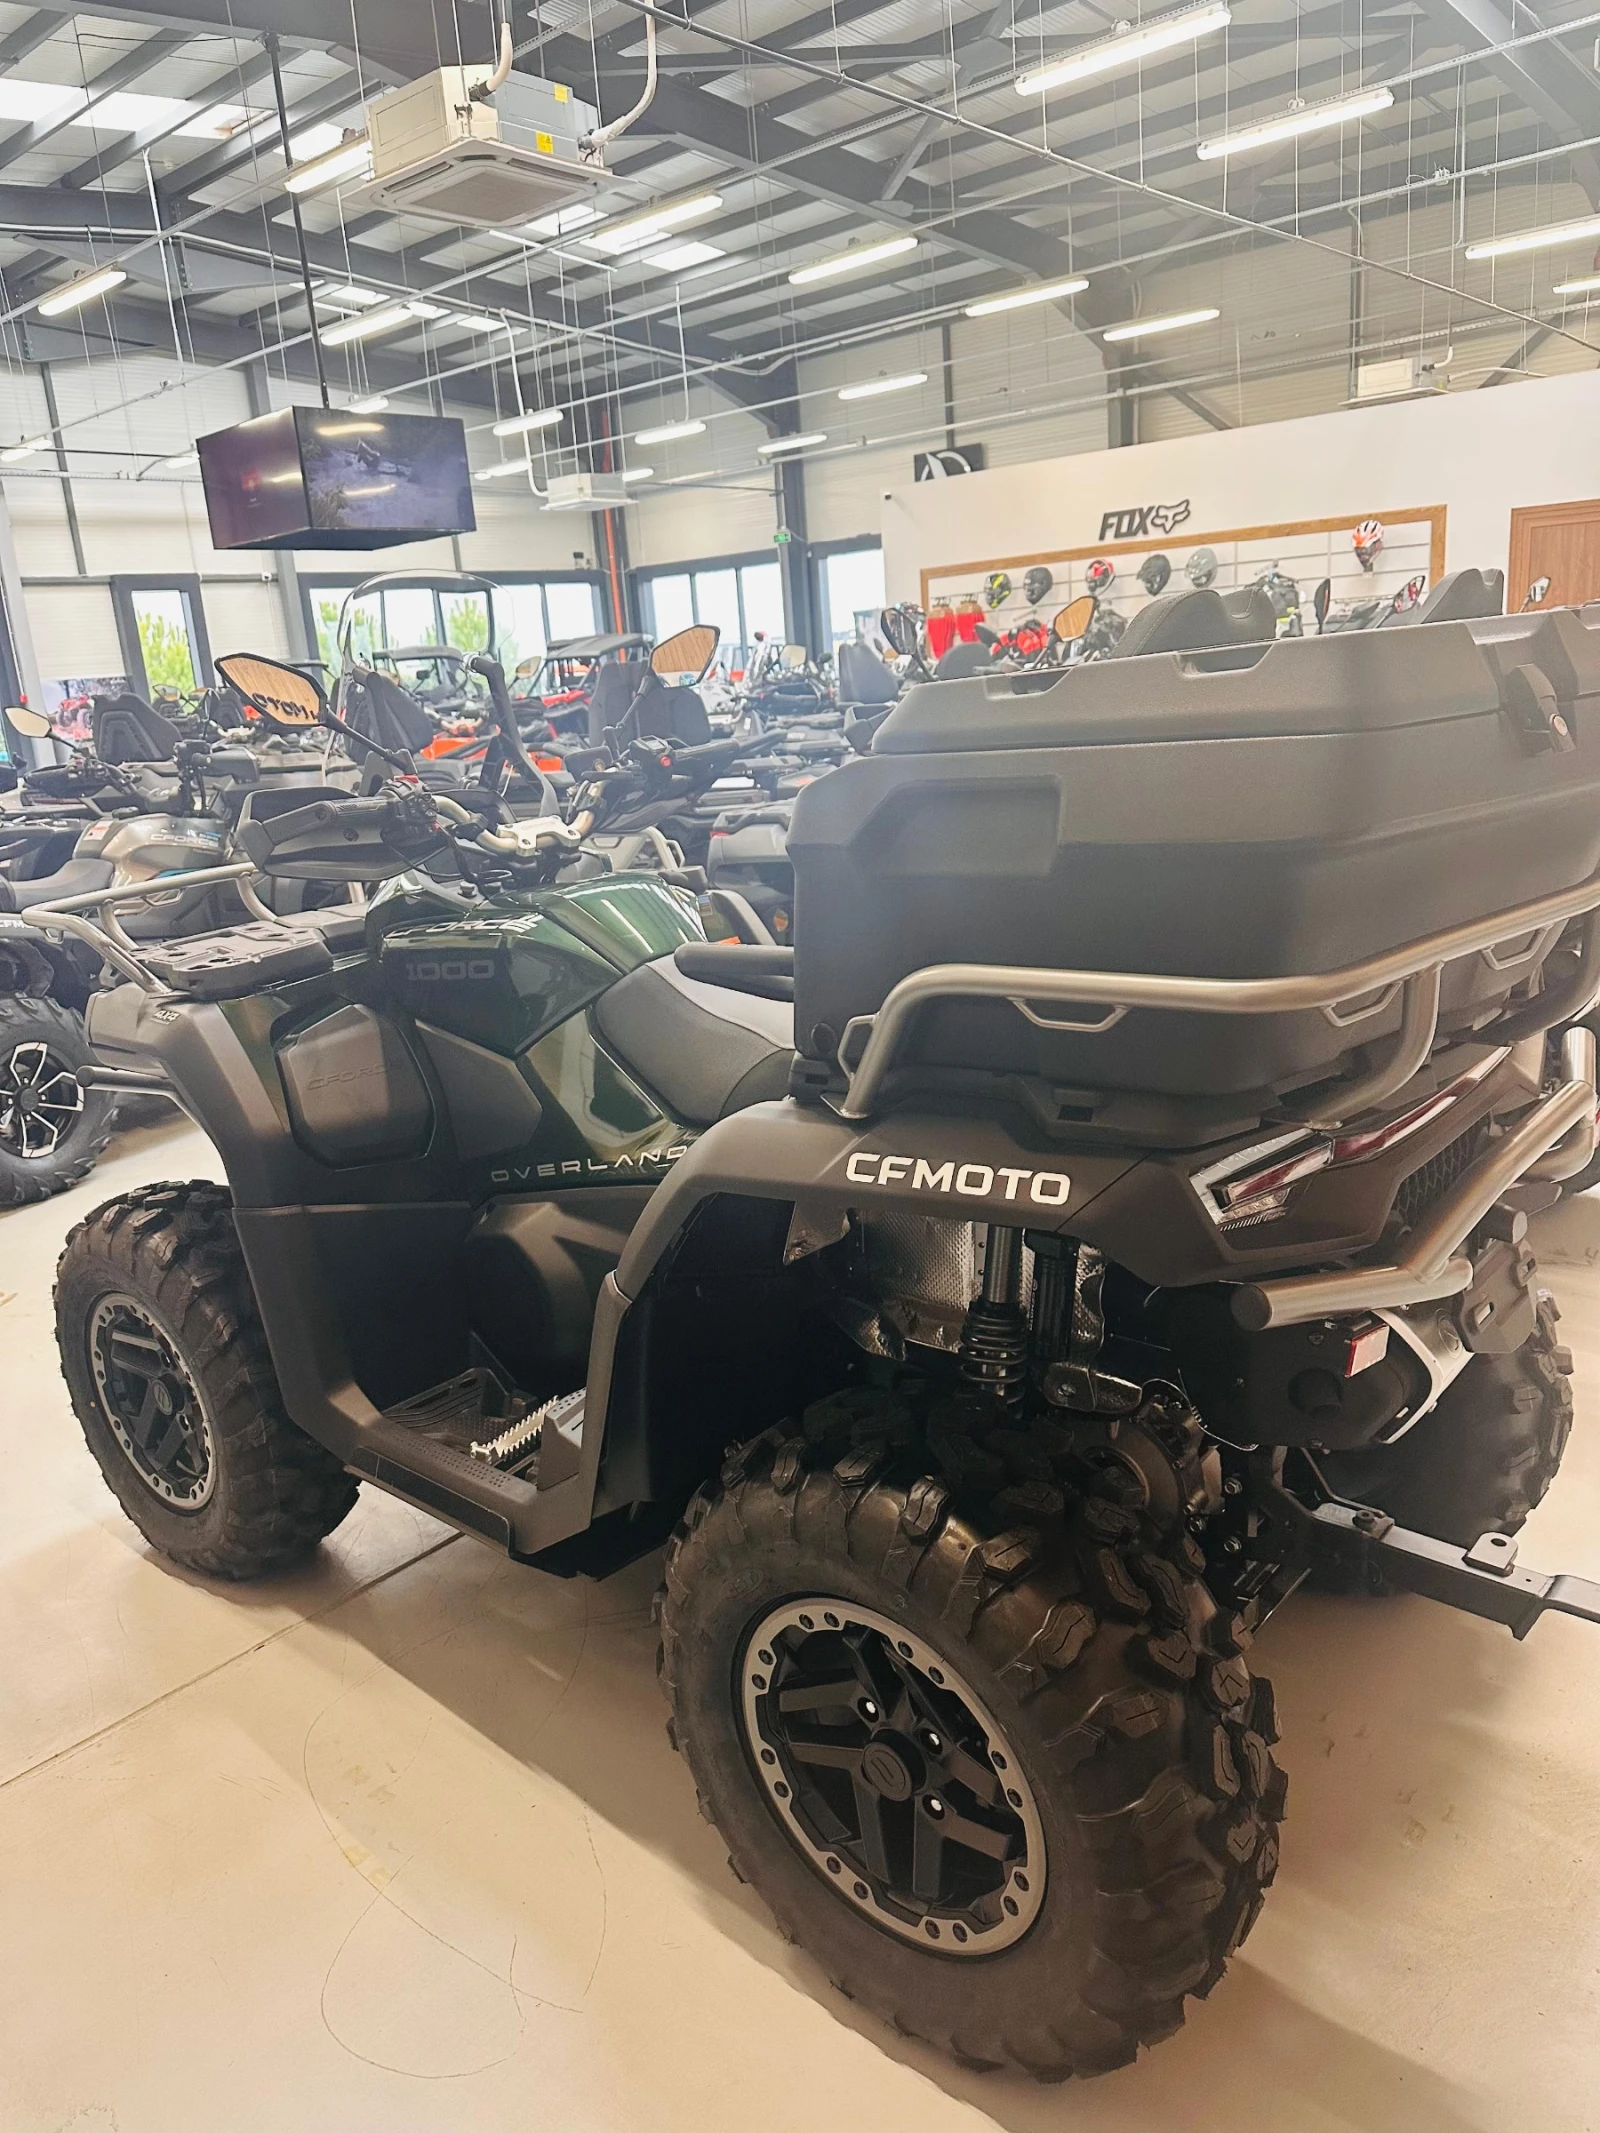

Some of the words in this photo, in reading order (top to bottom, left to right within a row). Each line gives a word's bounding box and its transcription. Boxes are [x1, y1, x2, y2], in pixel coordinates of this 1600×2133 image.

[1099, 505, 1155, 541] FOX
[405, 960, 495, 981] 1000
[491, 1145, 688, 1182] OVERLAND
[845, 1152, 1071, 1206] CFMOTO
